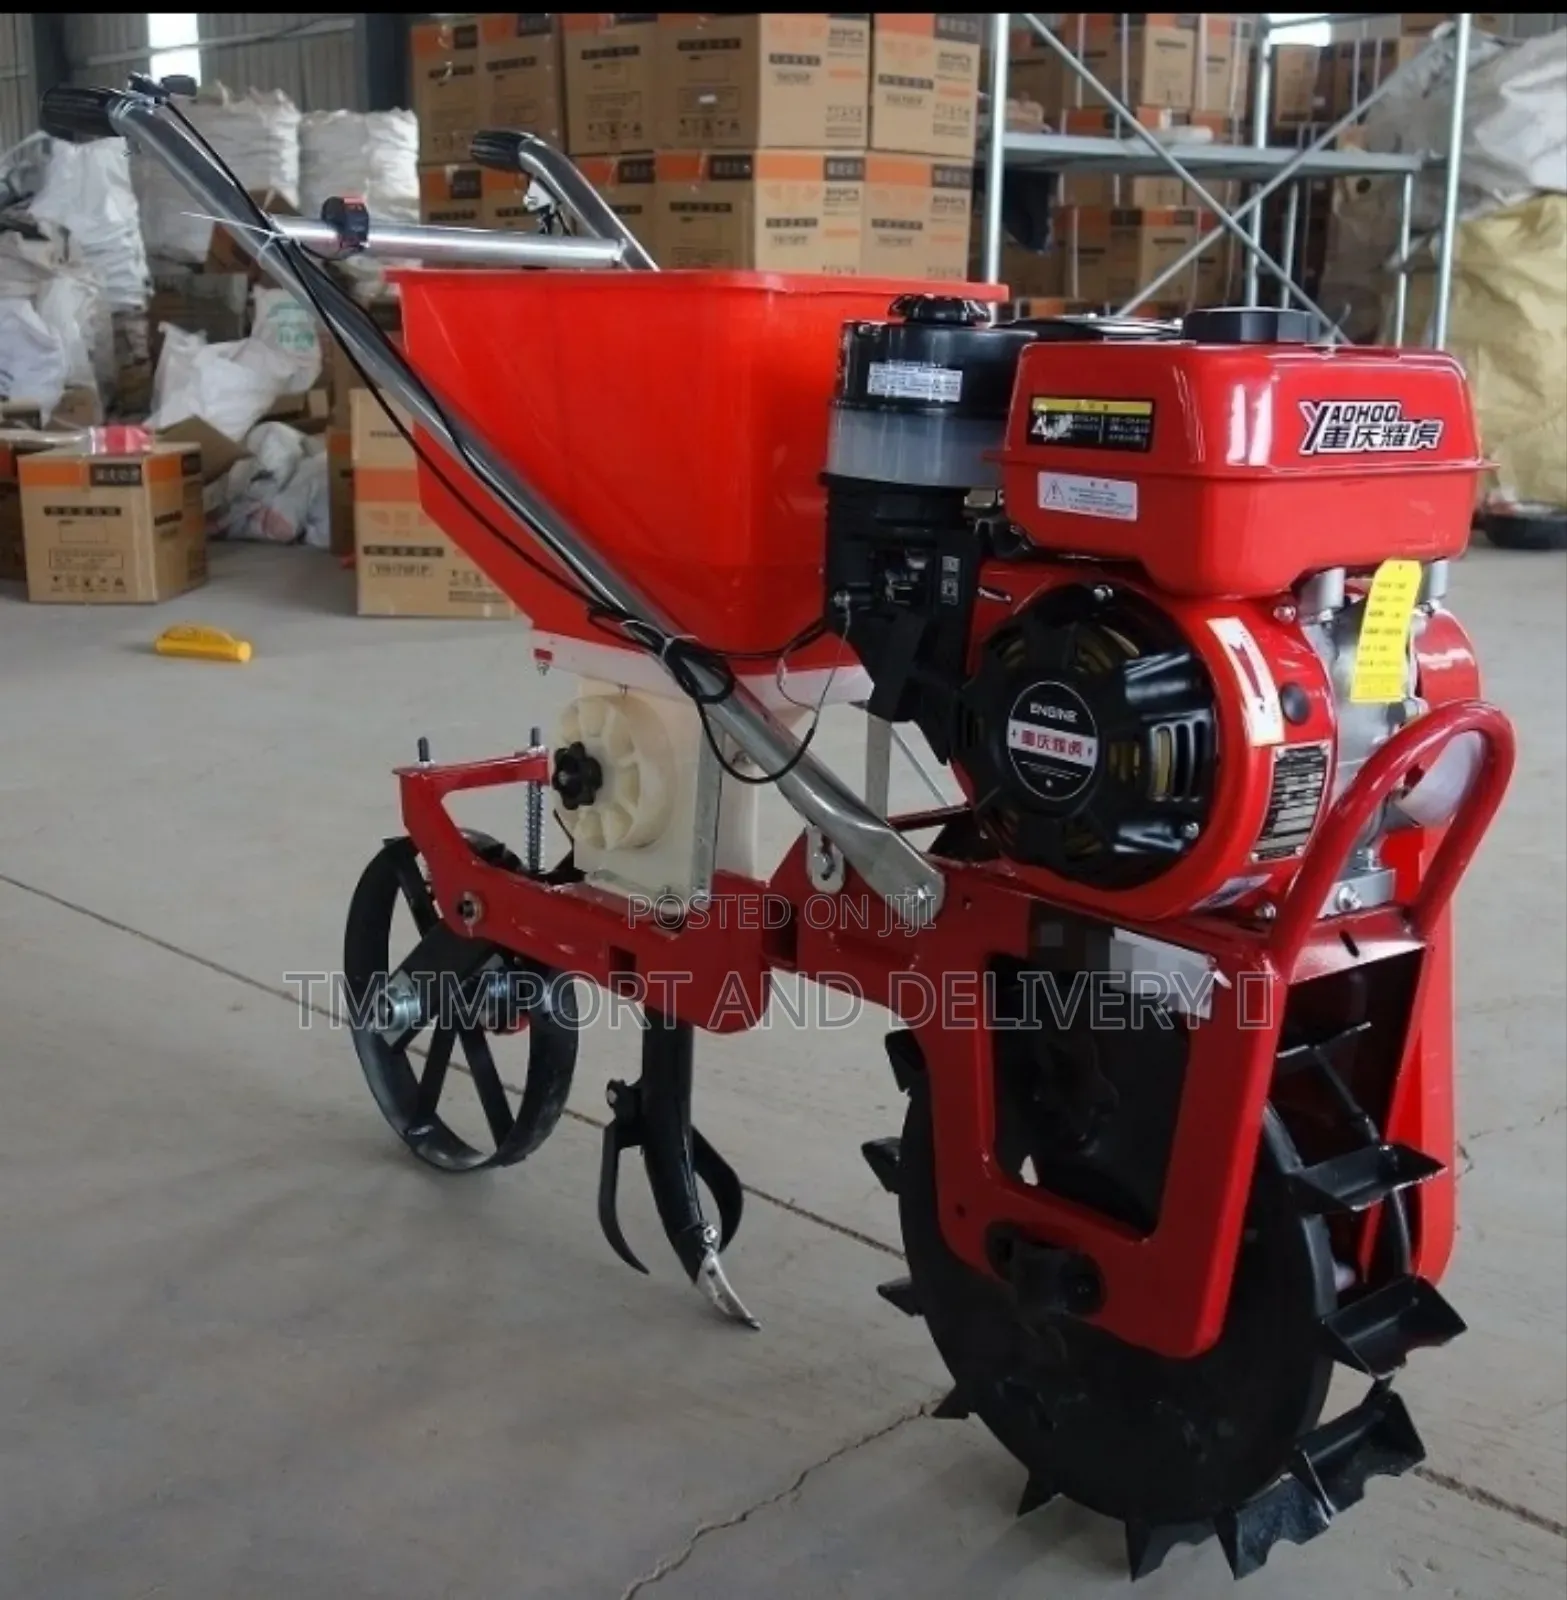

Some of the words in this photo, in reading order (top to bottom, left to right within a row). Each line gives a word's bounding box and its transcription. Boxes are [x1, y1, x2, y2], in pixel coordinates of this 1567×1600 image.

[1299, 401, 1401, 453] YAOHOO
[1320, 421, 1442, 450] 重庆耀虎
[1029, 702, 1079, 723] ENGINE
